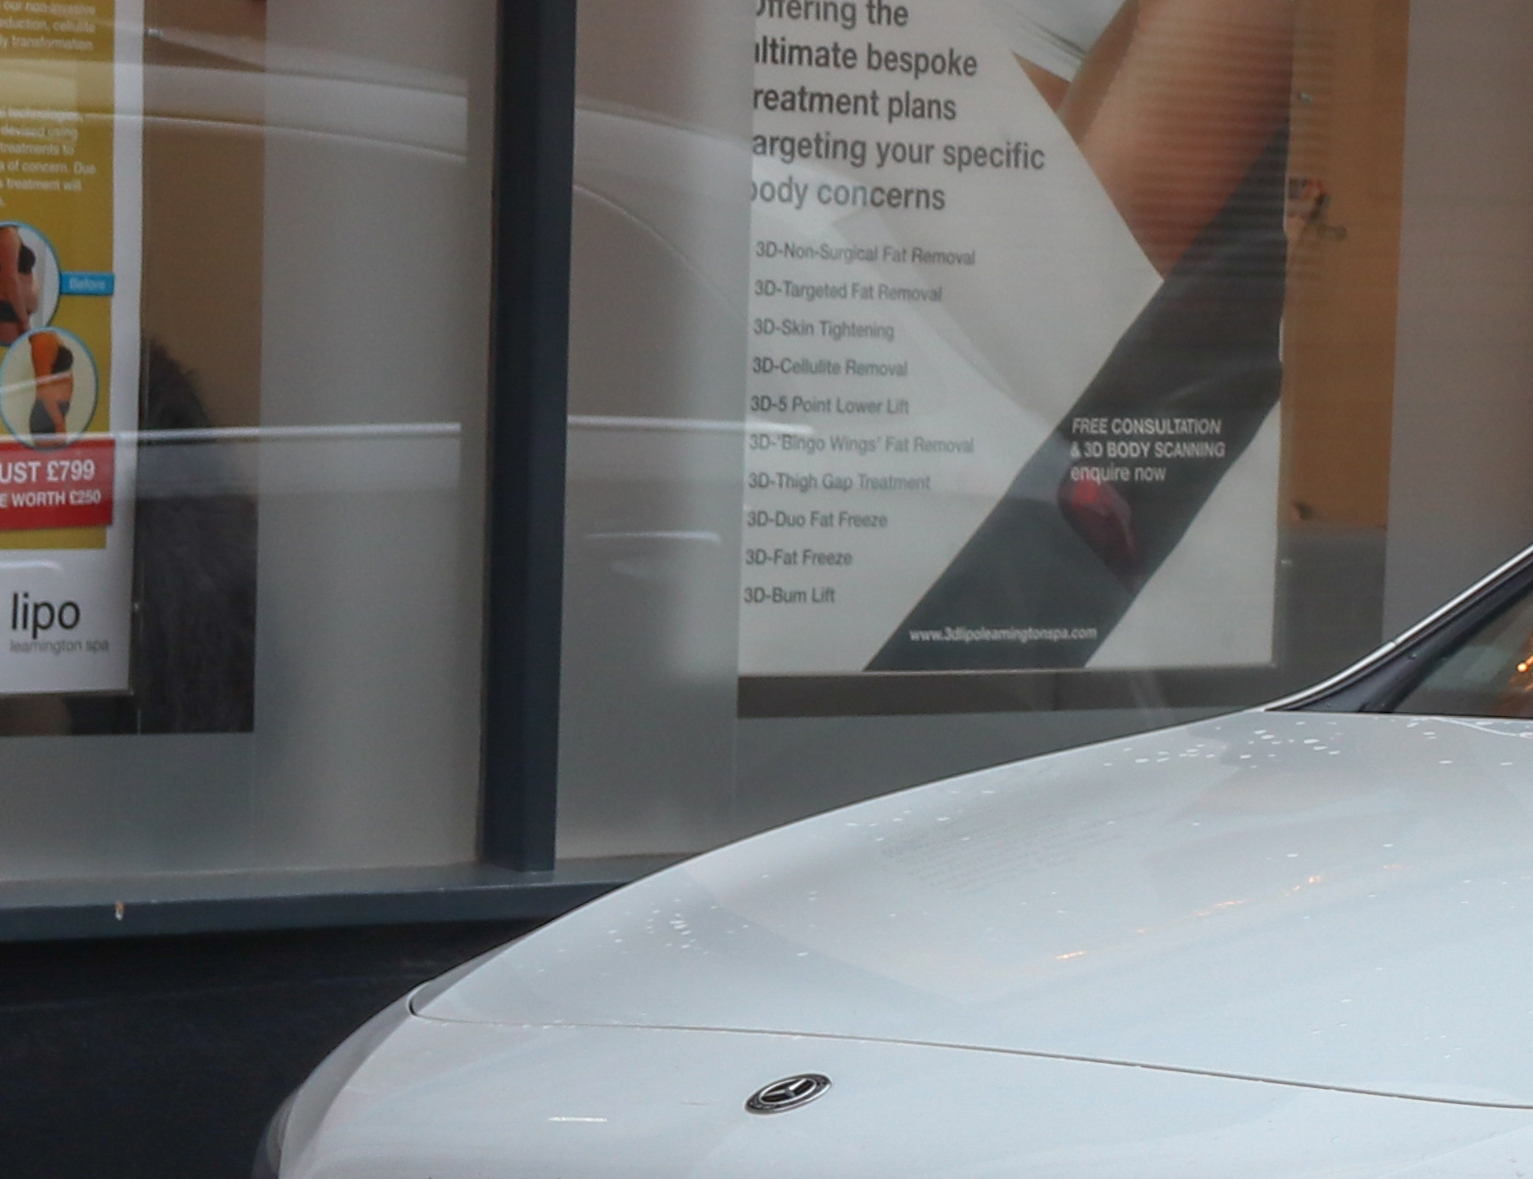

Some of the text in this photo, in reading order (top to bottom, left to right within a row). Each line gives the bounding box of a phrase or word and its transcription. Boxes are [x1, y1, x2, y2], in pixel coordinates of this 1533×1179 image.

[866, 0, 909, 27] the
[866, 43, 977, 80] bespoke
[887, 90, 957, 124] plans
[875, 140, 935, 169] your
[942, 140, 1046, 172] specific
[816, 180, 946, 211] concerns
[755, 241, 976, 266] 3D-Non-Surgical Fat Removal
[754, 279, 943, 302] 3D-Targeted Fat Removal
[753, 318, 895, 343] 3D-Skin Tightening
[752, 356, 909, 377] 3D-Cellulite Removal
[750, 395, 910, 414] 3D-5 Point Lower Lift
[1072, 418, 1222, 435] FREE CONSULTATION
[885, 436, 909, 453] Fat
[913, 437, 975, 454] Removal
[1070, 441, 1226, 458] & 3D BODY SCANNING
[46, 458, 96, 481] £799
[1070, 463, 1167, 486] enquire now
[748, 472, 931, 493] 3D-Thigh Gap Treatment
[11, 491, 67, 508] WORTH
[69, 489, 102, 506] £250
[747, 511, 888, 528] 3D-Duo Fat Freeze
[745, 549, 853, 566] 3D-Fat Freeze
[743, 587, 835, 604] 3D-Bum Lift
[11, 592, 81, 640] lipo
